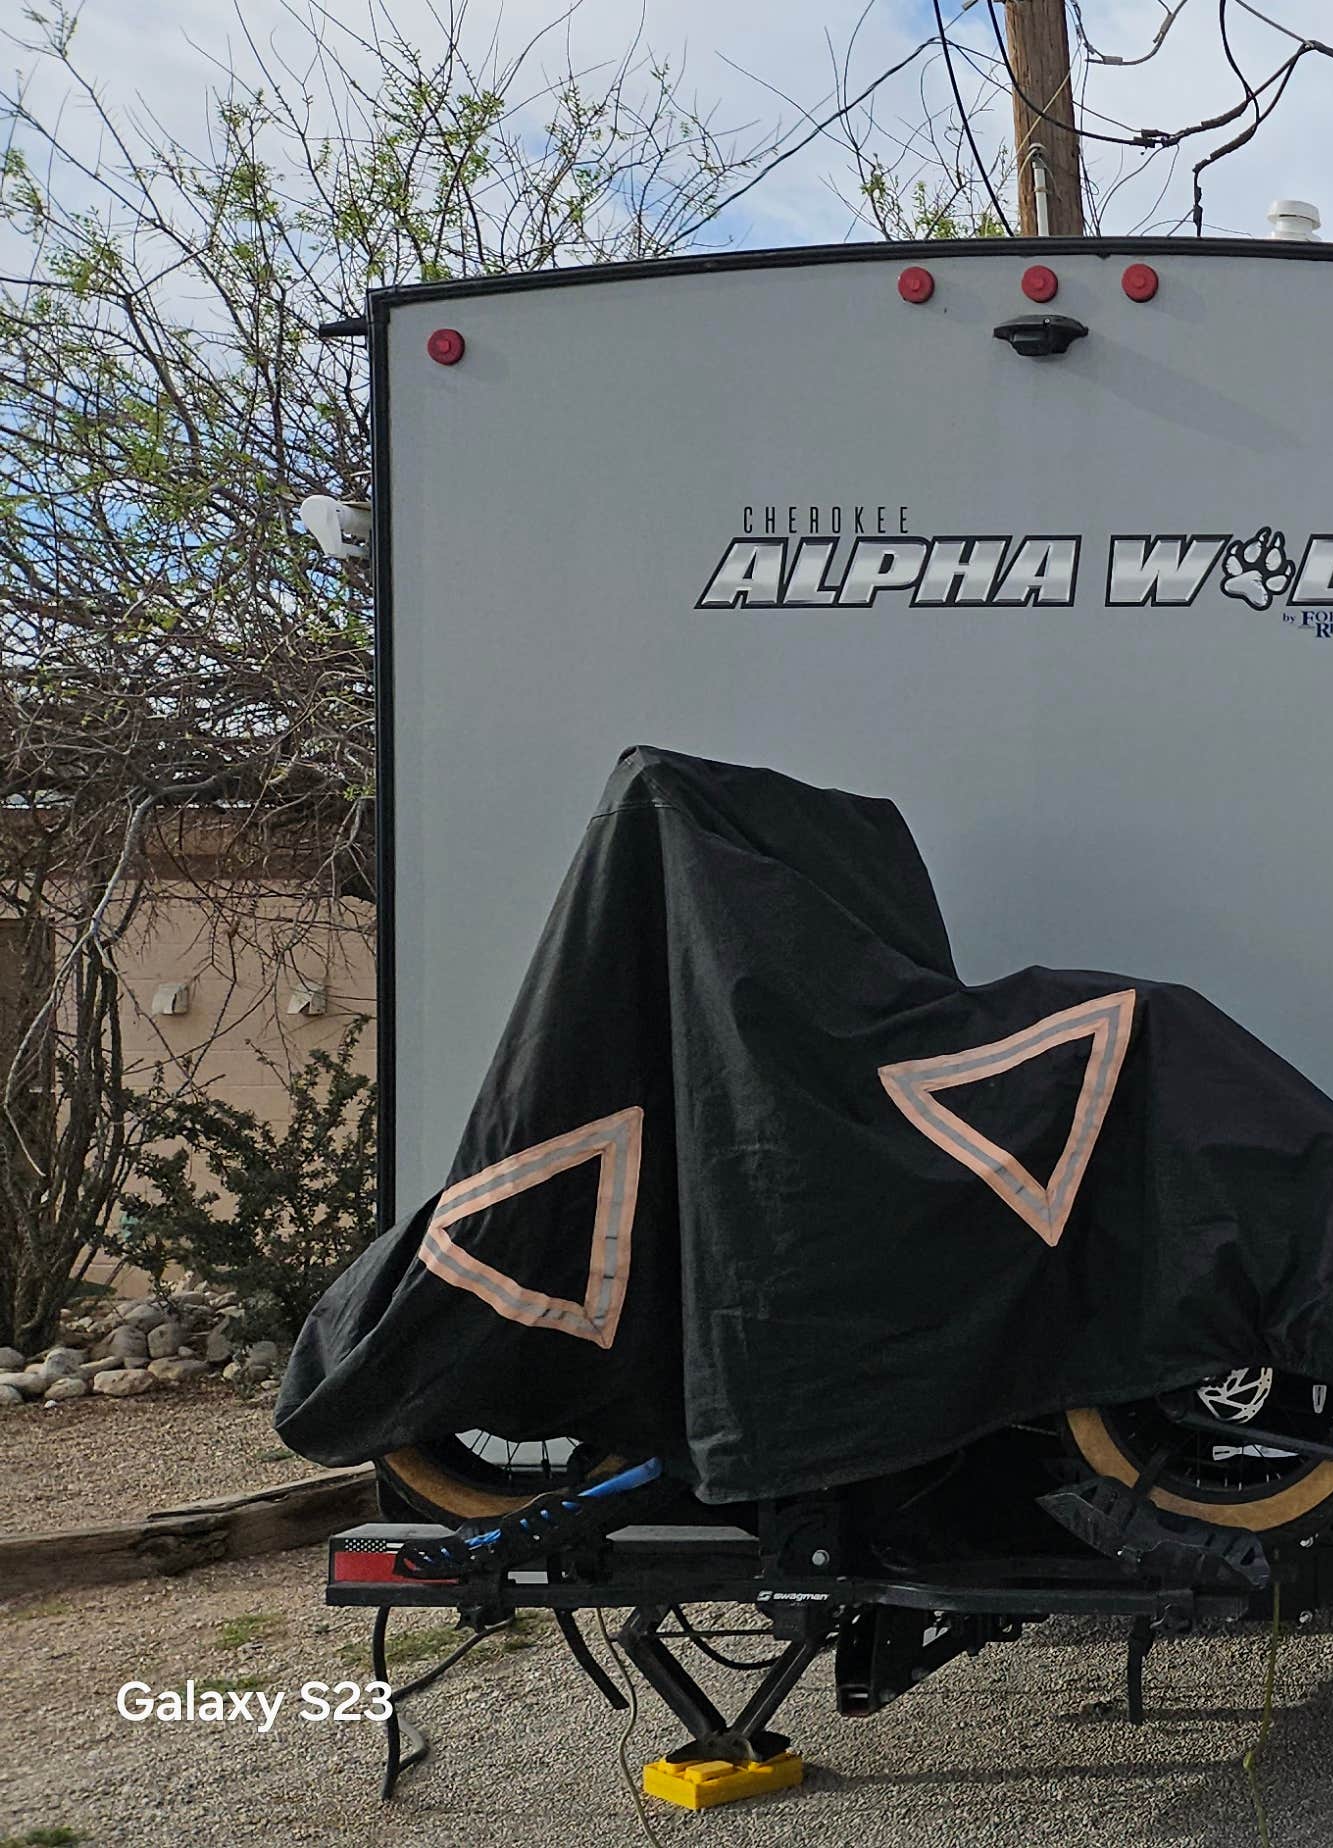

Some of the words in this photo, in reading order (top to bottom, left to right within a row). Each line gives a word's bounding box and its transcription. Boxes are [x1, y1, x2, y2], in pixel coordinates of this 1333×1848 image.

[743, 506, 909, 534] CHEROKEE
[694, 533, 1081, 609] ALPHA
[1282, 612, 1296, 624] by
